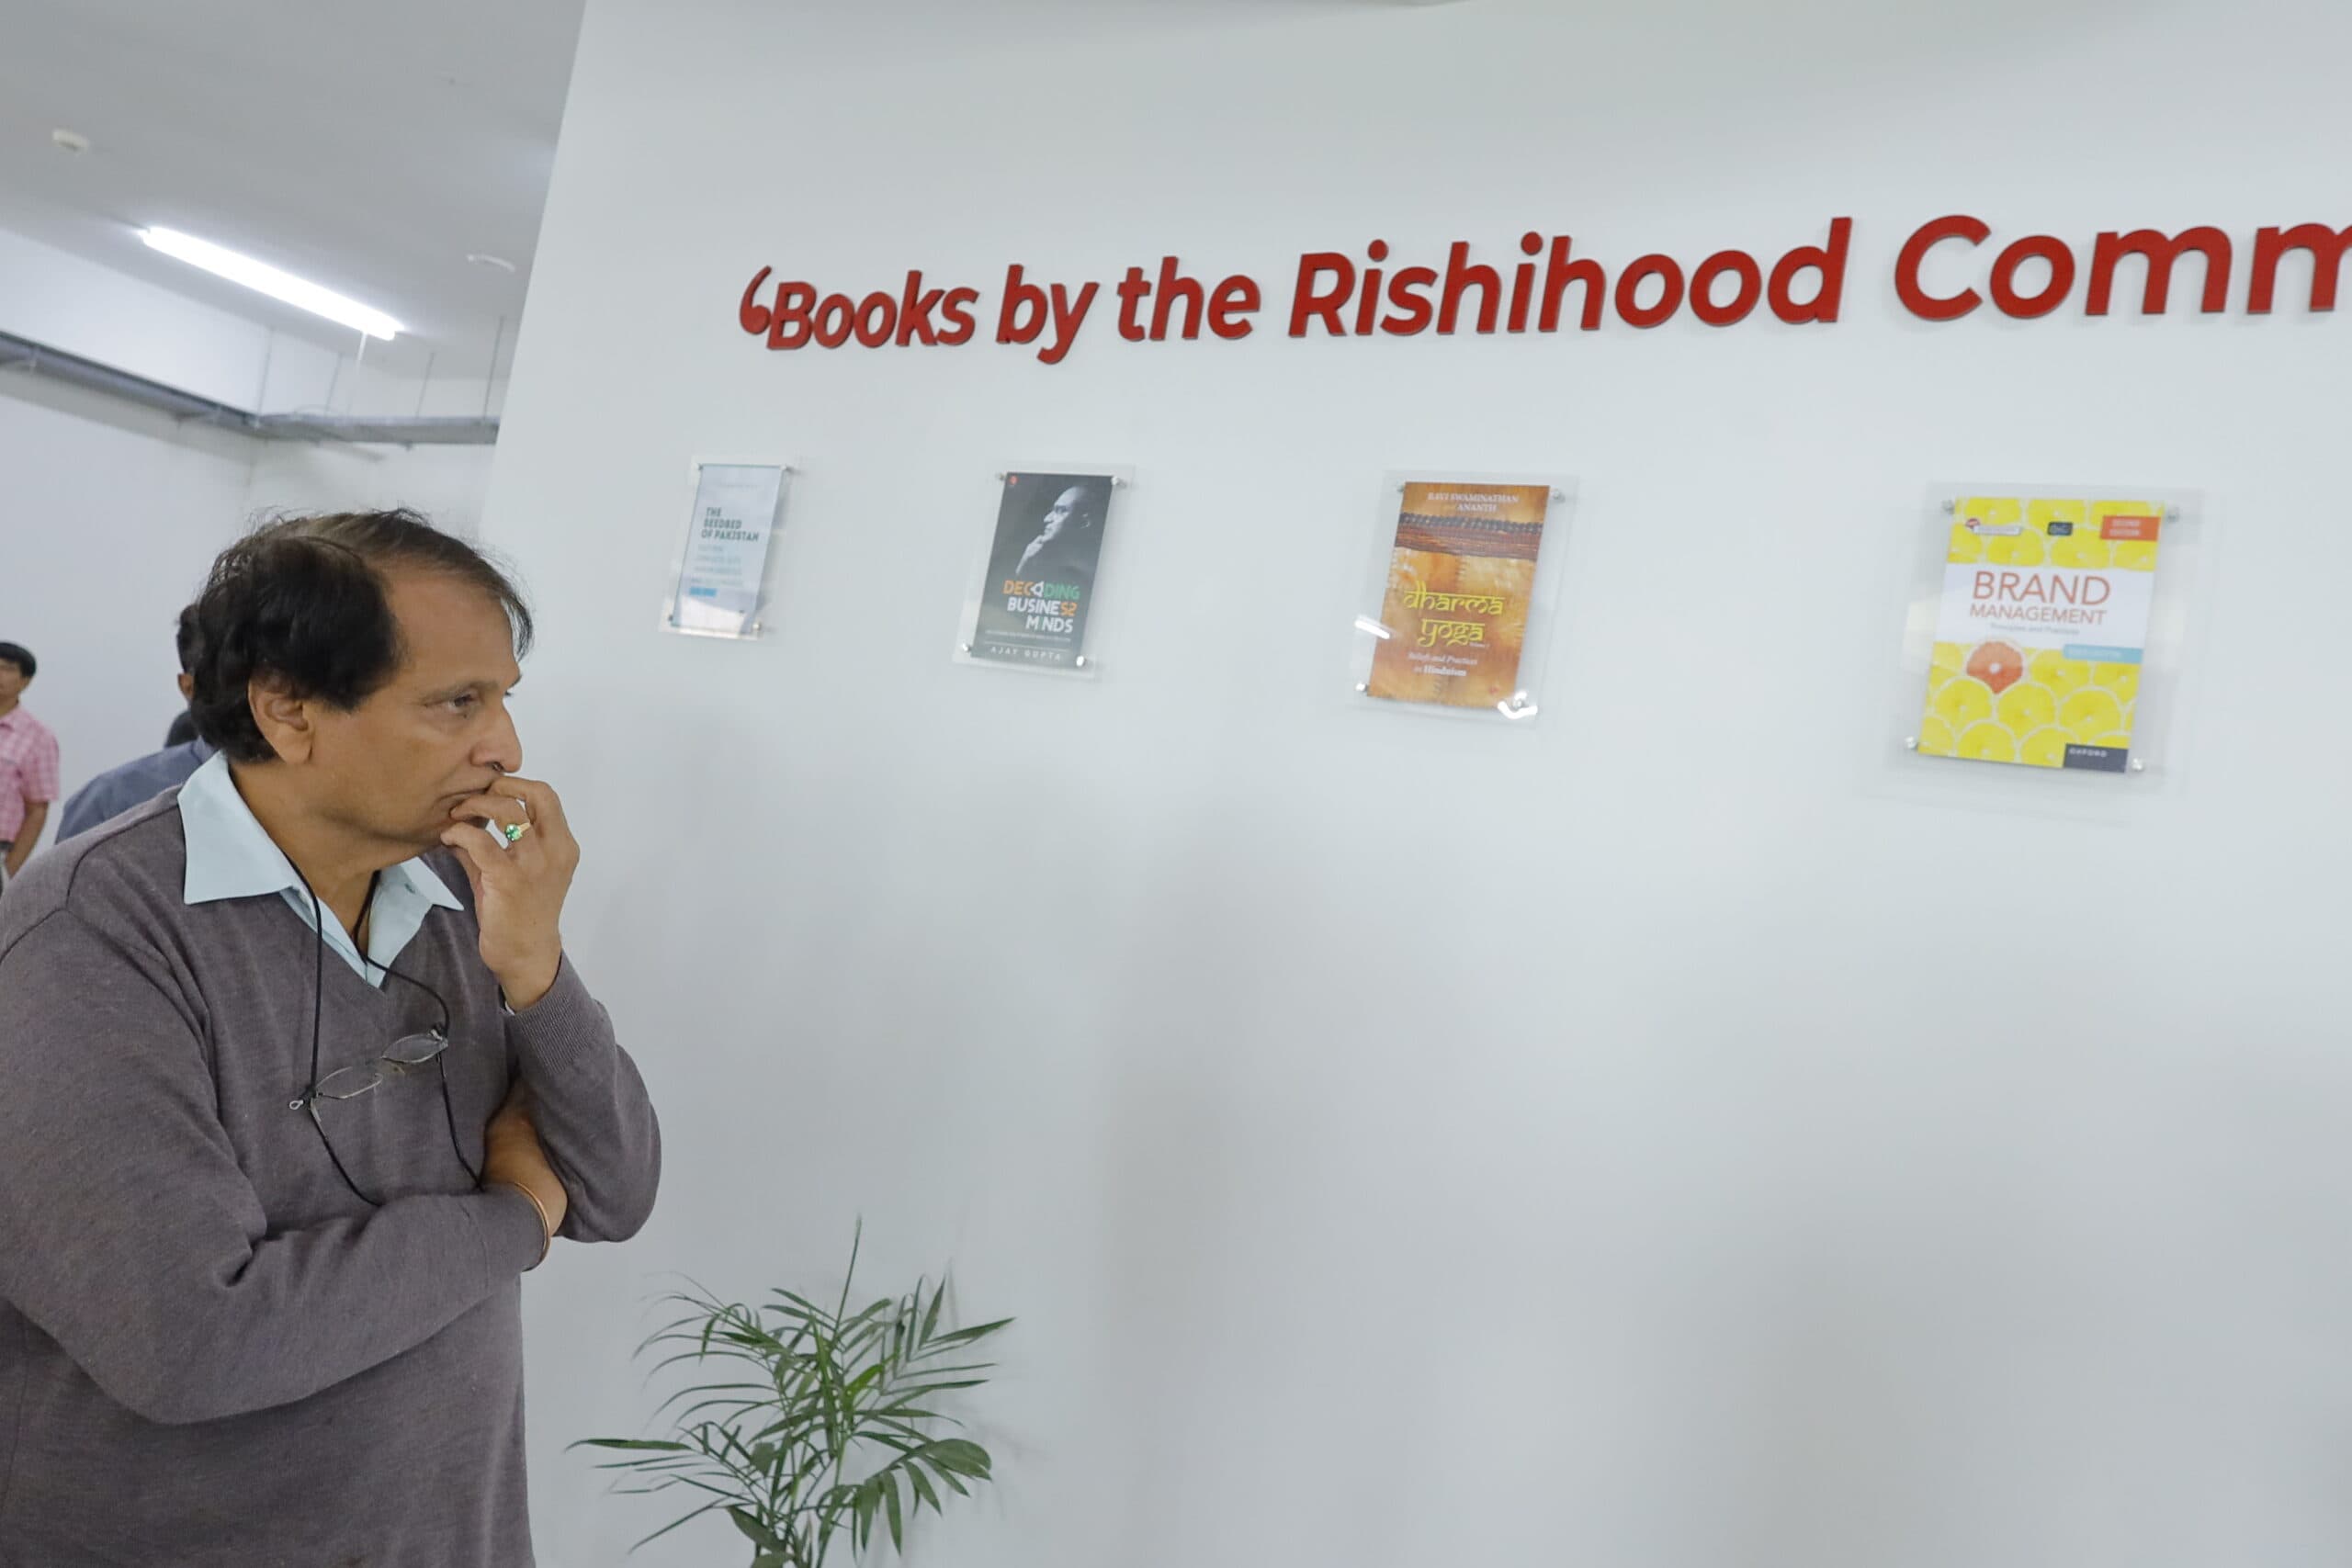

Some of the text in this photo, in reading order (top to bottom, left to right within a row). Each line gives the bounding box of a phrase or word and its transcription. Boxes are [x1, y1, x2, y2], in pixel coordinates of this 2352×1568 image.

[997, 264, 1100, 364] by
[1117, 255, 1261, 341] the
[1288, 217, 1853, 337] Rishihood
[1894, 214, 2352, 321] Comm
[706, 506, 722, 517] THE
[701, 529, 759, 542] OF PAKISTAN
[1402, 580, 1505, 615] dharma
[1972, 570, 2111, 606] BRAND
[1969, 604, 2108, 626] MANAGEMENT
[1417, 618, 1486, 648] yoga
[990, 646, 1061, 661] AJAY GUPTA
